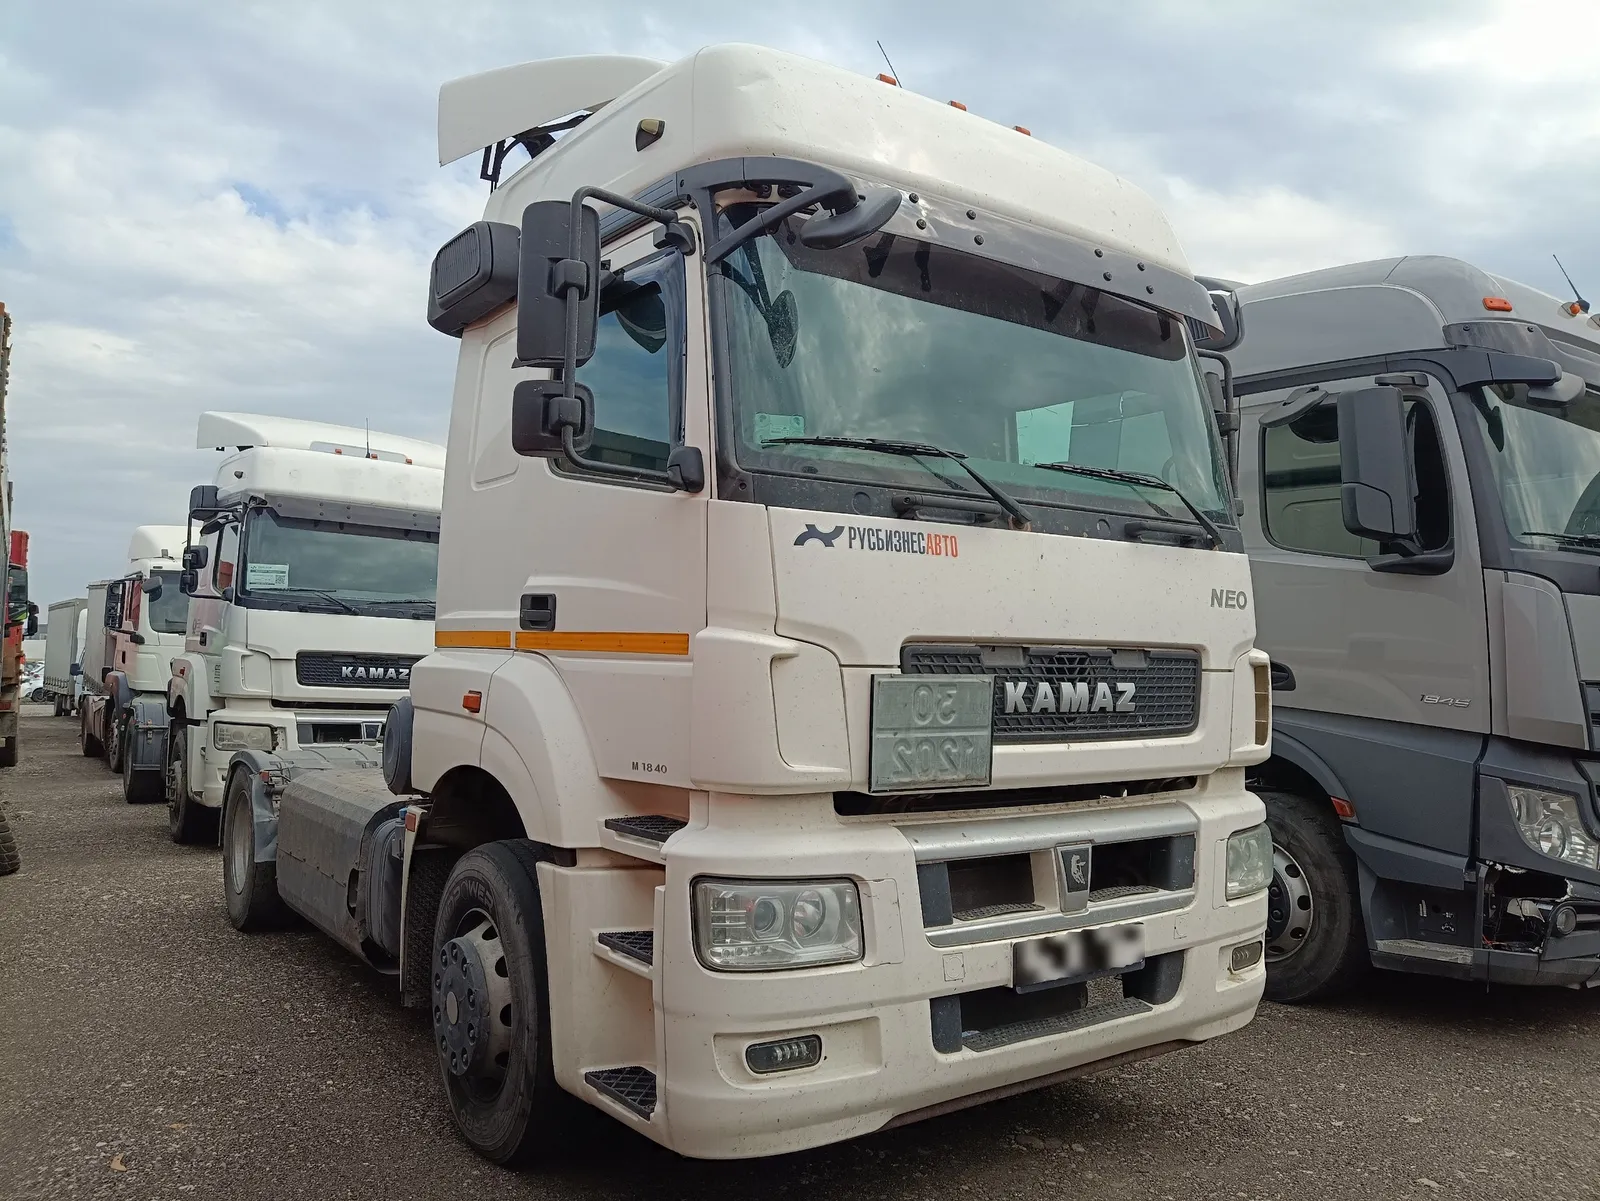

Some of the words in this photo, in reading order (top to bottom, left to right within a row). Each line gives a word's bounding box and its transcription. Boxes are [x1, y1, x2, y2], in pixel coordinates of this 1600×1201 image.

[848, 526, 959, 558] РУСБИЗНЕСАВТО
[1210, 588, 1248, 611] NEO
[341, 666, 410, 680] KAMAZ
[1004, 681, 1136, 714] KAMAZ
[1420, 694, 1471, 708] 1845
[631, 761, 639, 771] M
[641, 762, 668, 774] 1840
